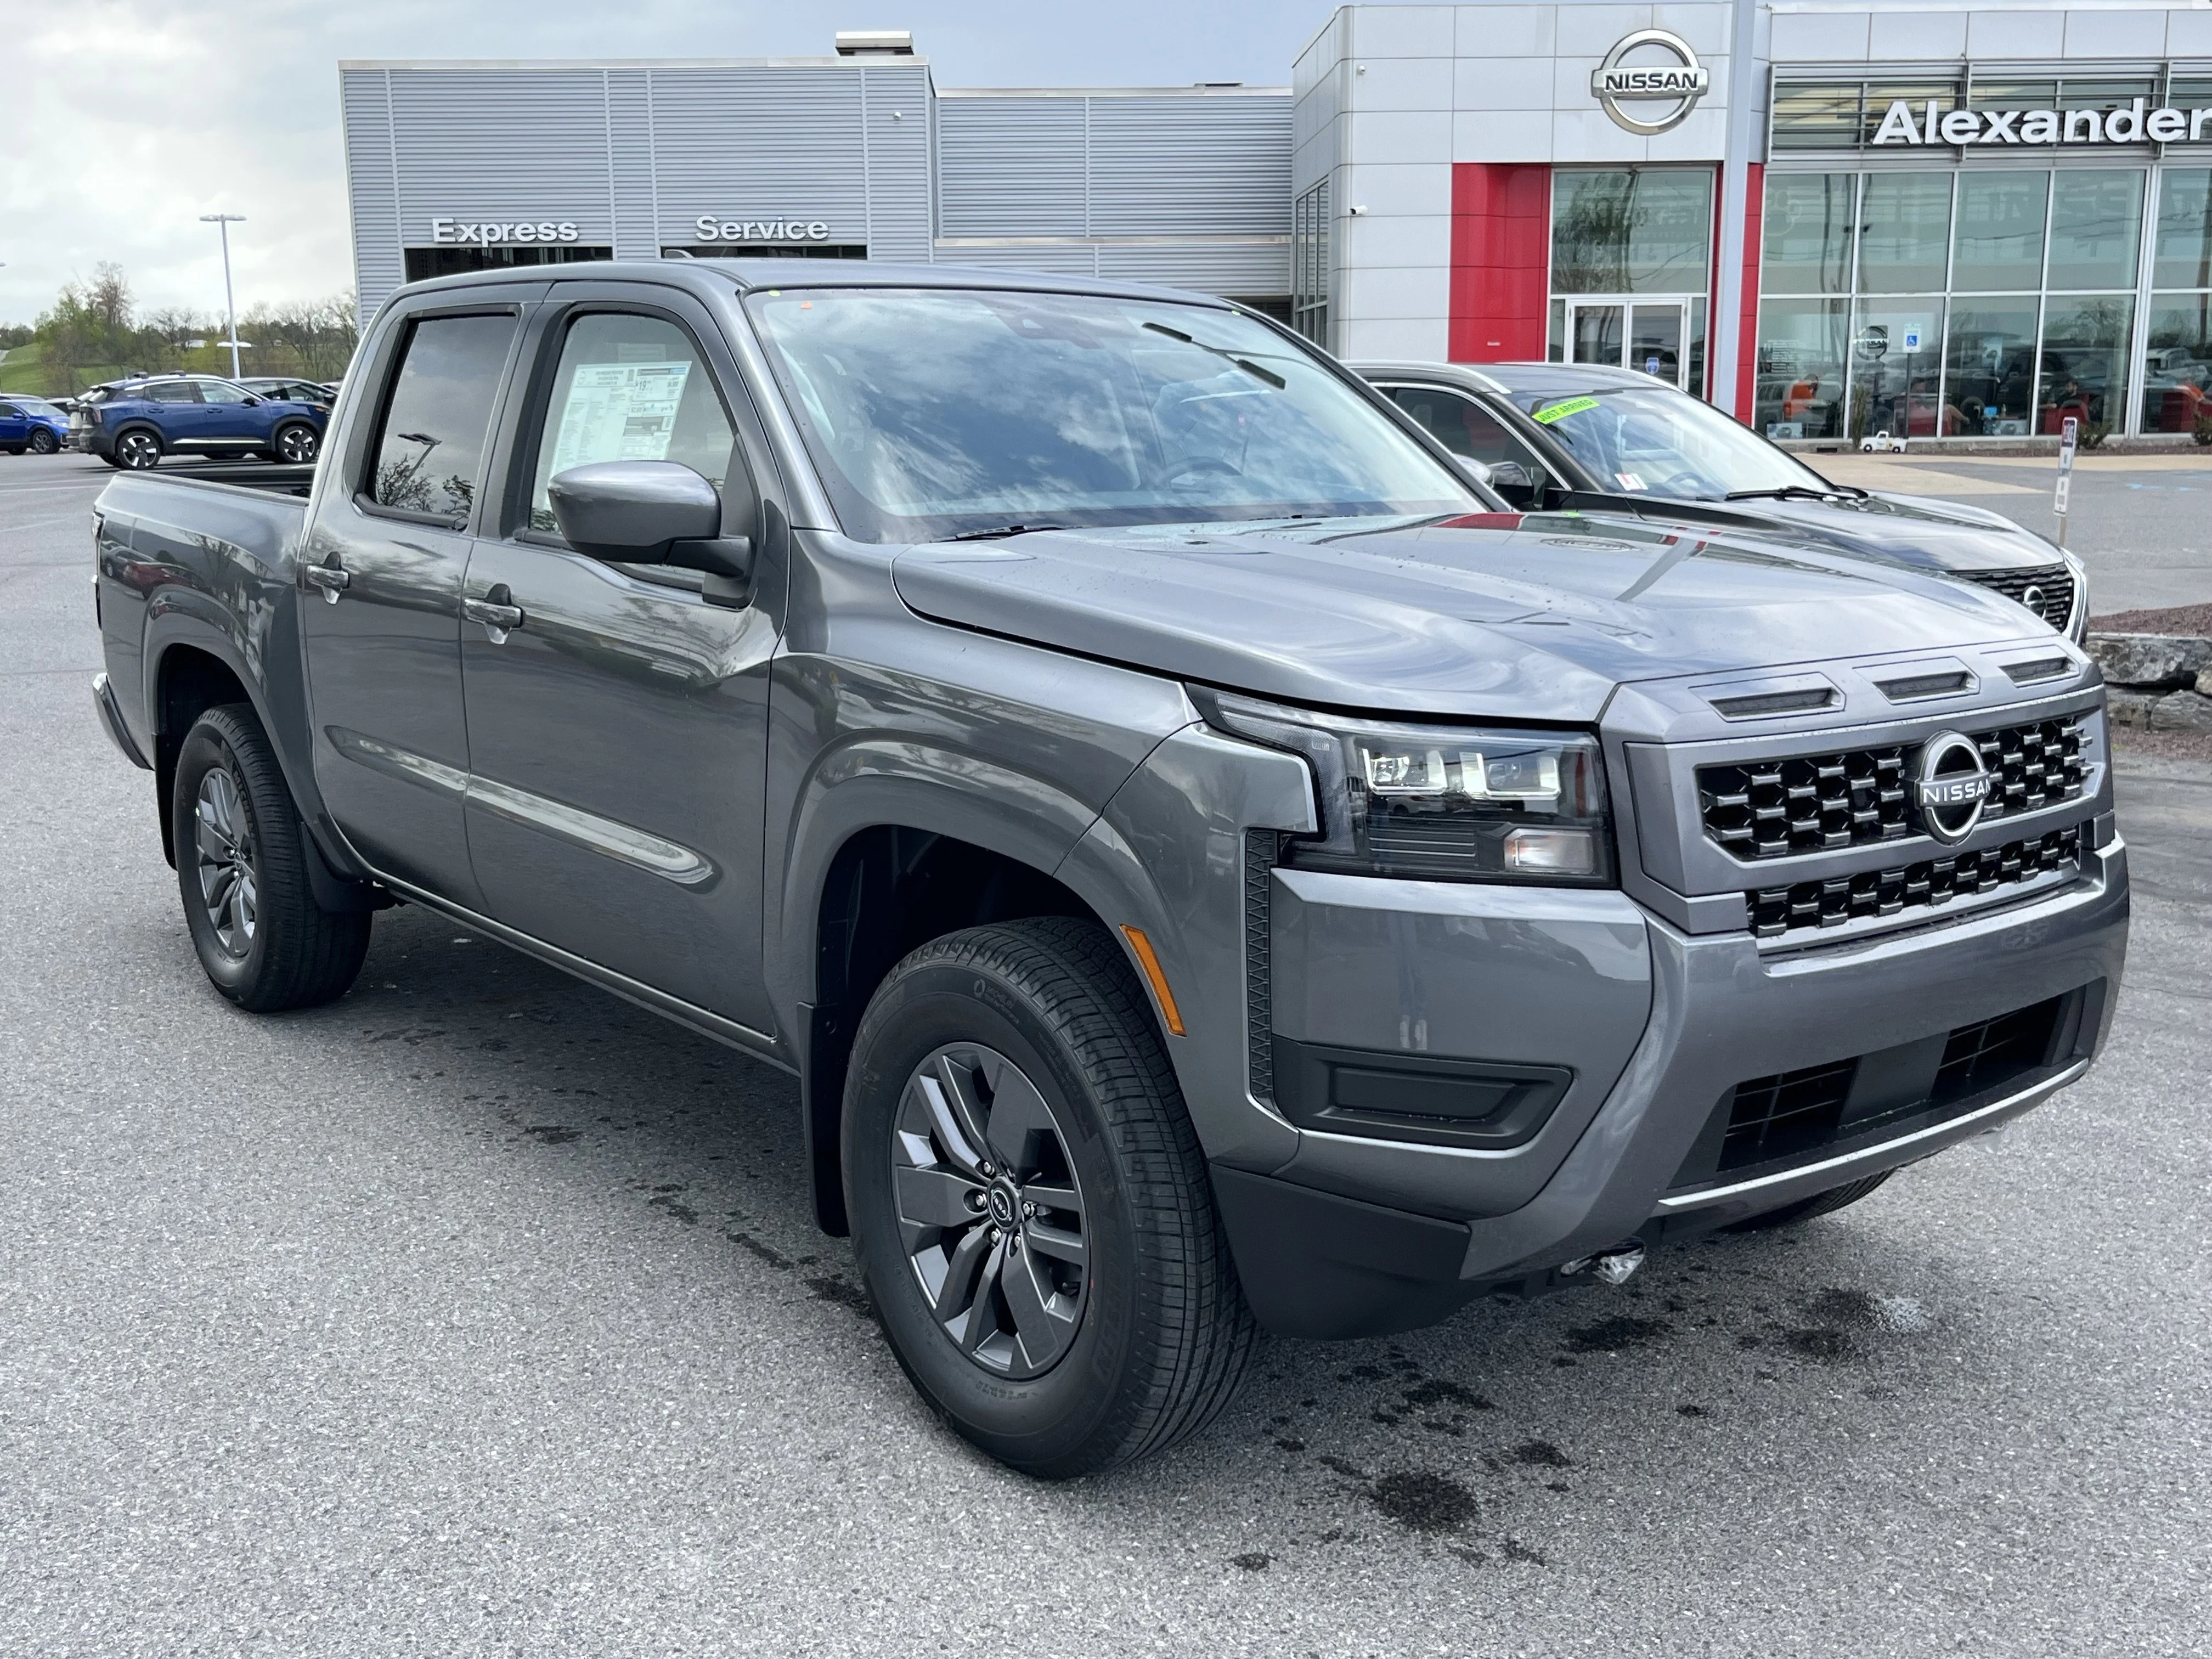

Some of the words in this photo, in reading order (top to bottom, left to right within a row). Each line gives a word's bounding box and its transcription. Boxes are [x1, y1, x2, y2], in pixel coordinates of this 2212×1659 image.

[1605, 72, 1698, 91] NISSAN
[1872, 98, 2212, 145] Alexander
[432, 218, 578, 247] Express
[696, 216, 829, 240] Service
[1538, 409, 1559, 422] JUST
[1559, 399, 1593, 413] ARRIVED
[1923, 778, 1991, 804] NISSAN
